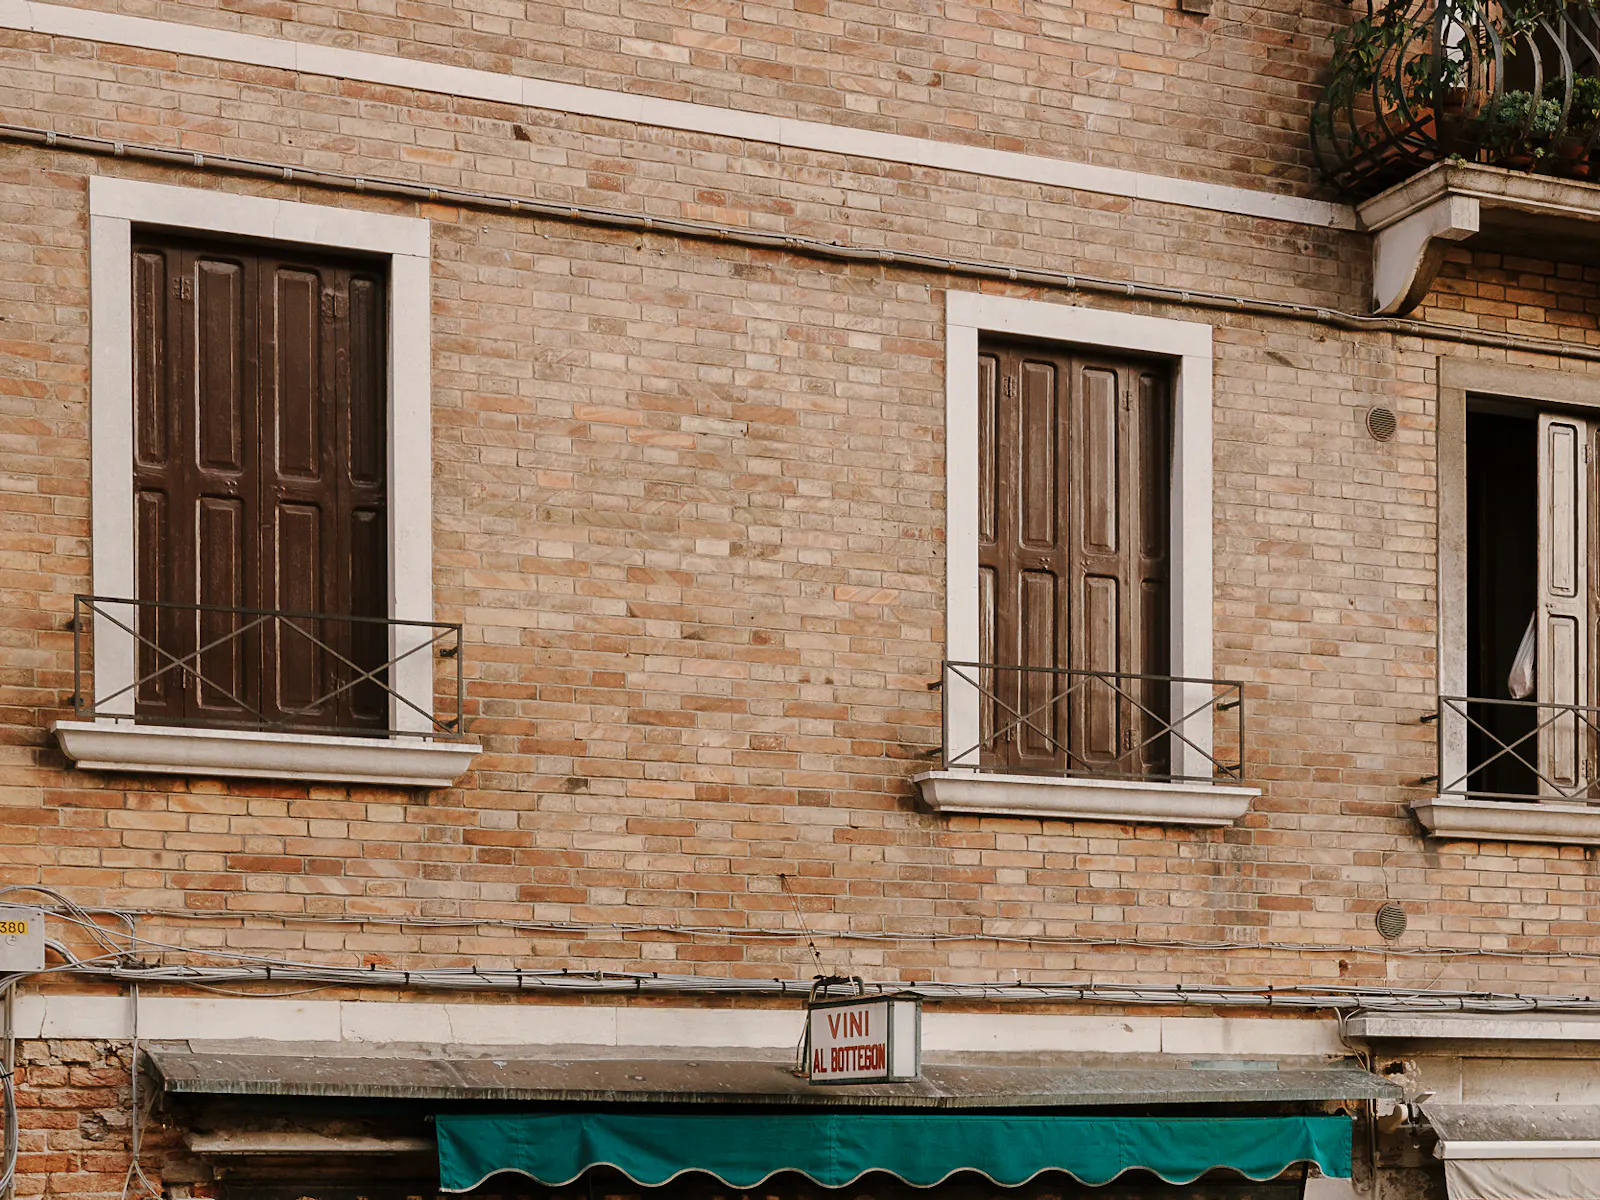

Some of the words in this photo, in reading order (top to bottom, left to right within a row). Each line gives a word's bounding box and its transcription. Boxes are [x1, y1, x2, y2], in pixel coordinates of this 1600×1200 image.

[827, 1009, 869, 1040] VINI
[813, 1048, 827, 1073] AL
[831, 1043, 886, 1073] BOTTEGON
